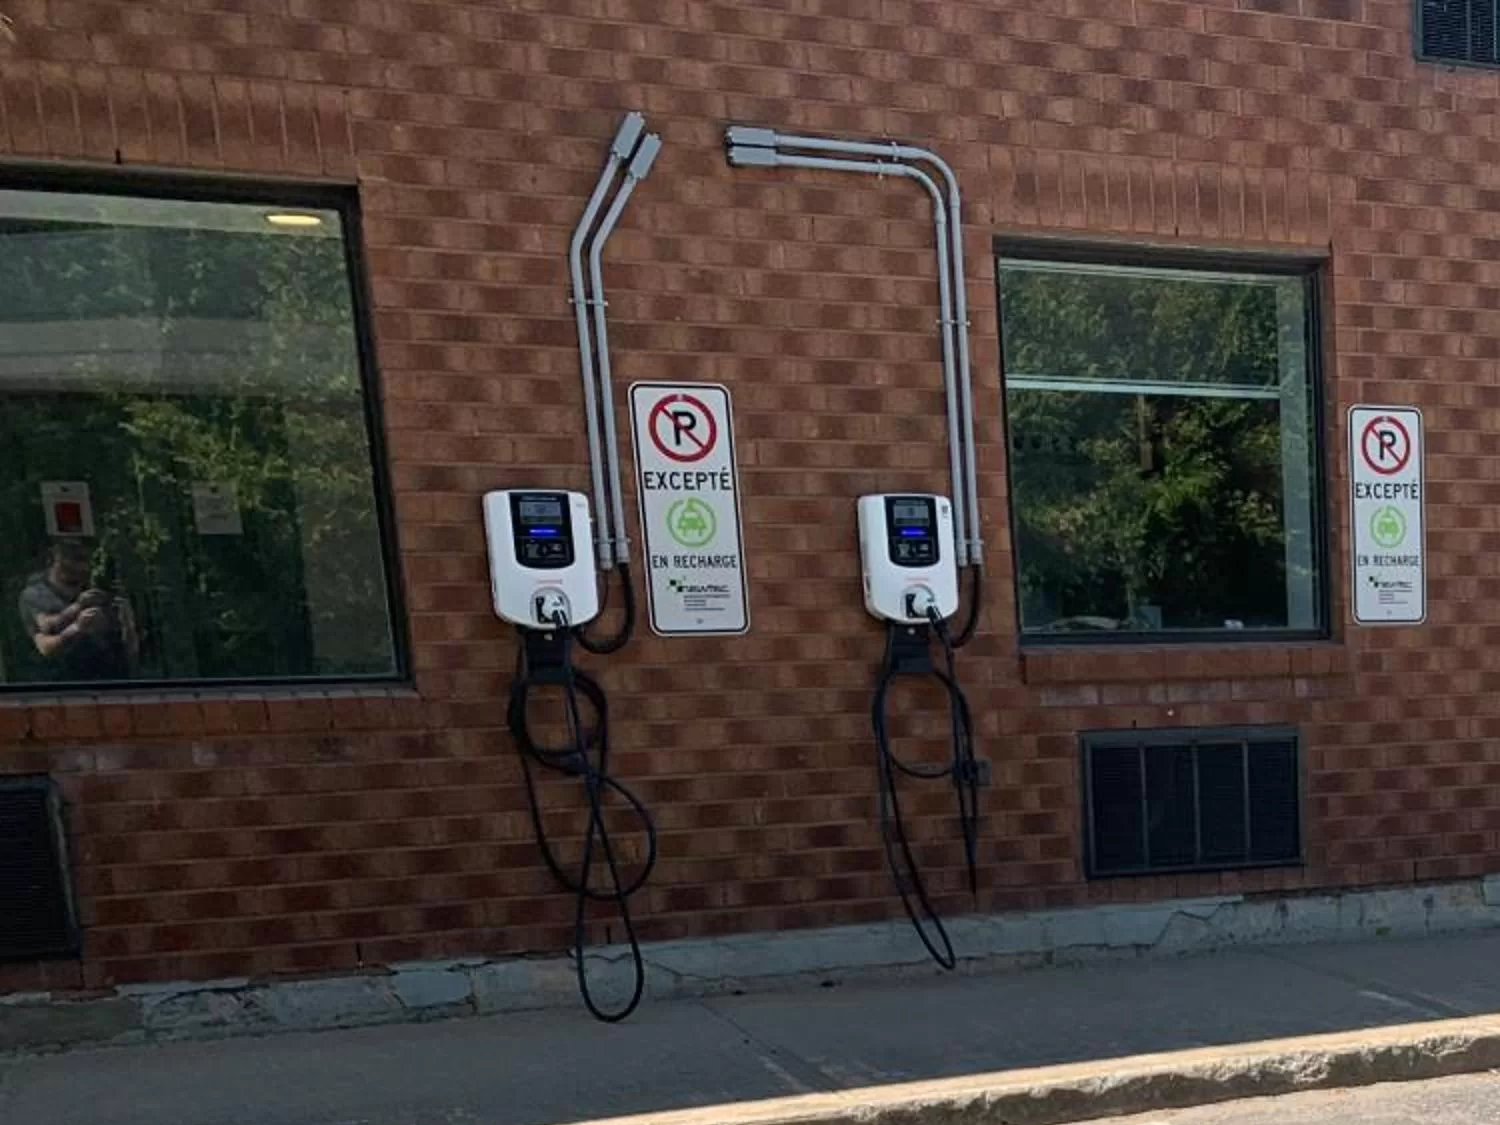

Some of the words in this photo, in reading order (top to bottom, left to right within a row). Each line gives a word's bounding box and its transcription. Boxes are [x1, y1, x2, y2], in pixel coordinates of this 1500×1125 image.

[672, 411, 696, 446] P
[1379, 431, 1397, 460] P
[643, 467, 732, 490] EXCEPTÉ
[1355, 480, 1419, 499] EXCEPTÉ
[652, 554, 669, 568] EN
[673, 554, 737, 568] RECHARGE
[1357, 555, 1369, 567] EN
[1373, 555, 1419, 567] RECHARGE
